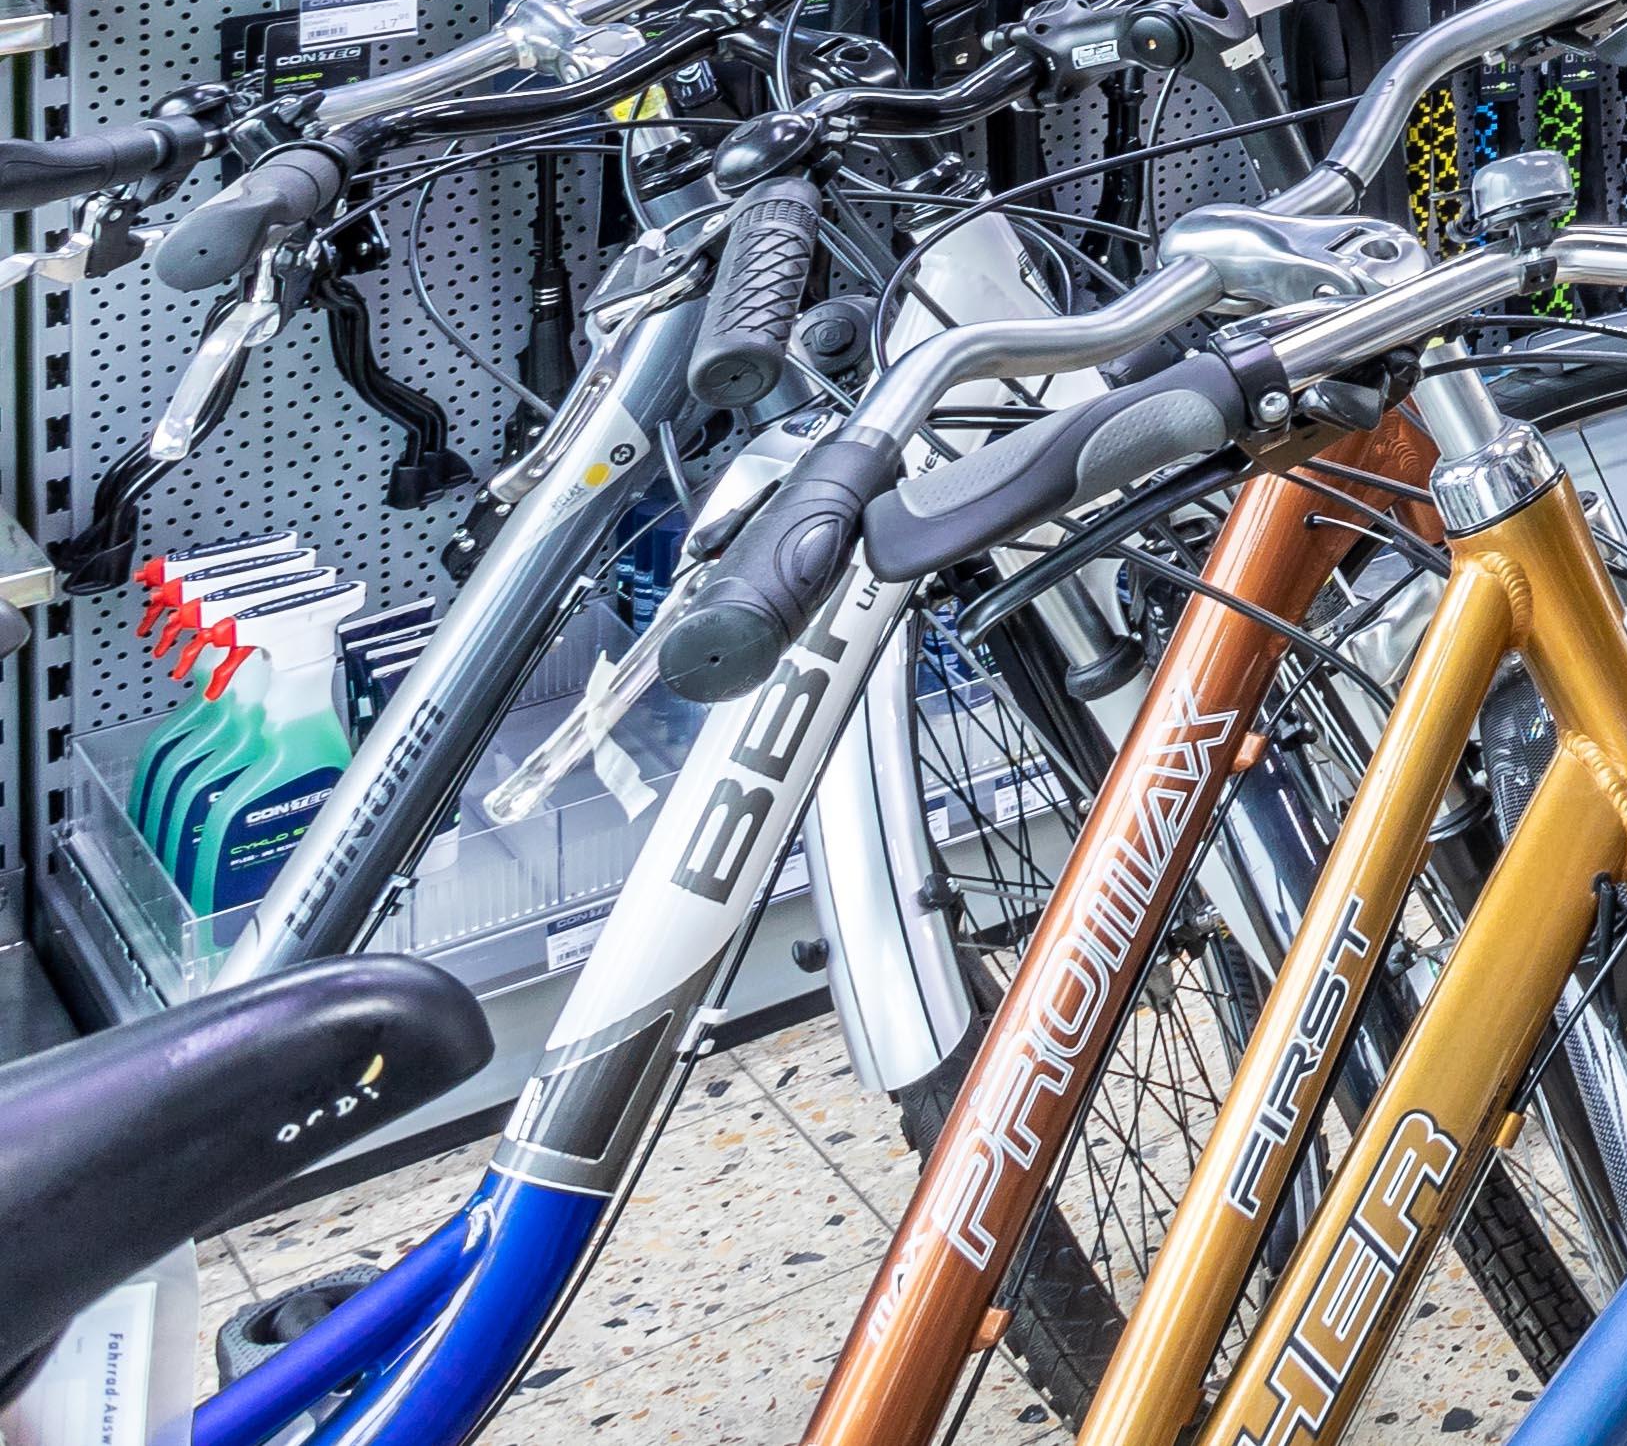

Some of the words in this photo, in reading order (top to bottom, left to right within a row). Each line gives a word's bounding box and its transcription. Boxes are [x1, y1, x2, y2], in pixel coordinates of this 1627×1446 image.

[284, 697, 445, 941] WINORA
[945, 677, 1241, 1272] PROMAX
[1224, 897, 1369, 1220] FIRST
[104, 1331, 127, 1446] Fahrrad-Ausw
[1234, 1109, 1465, 1446] HER
